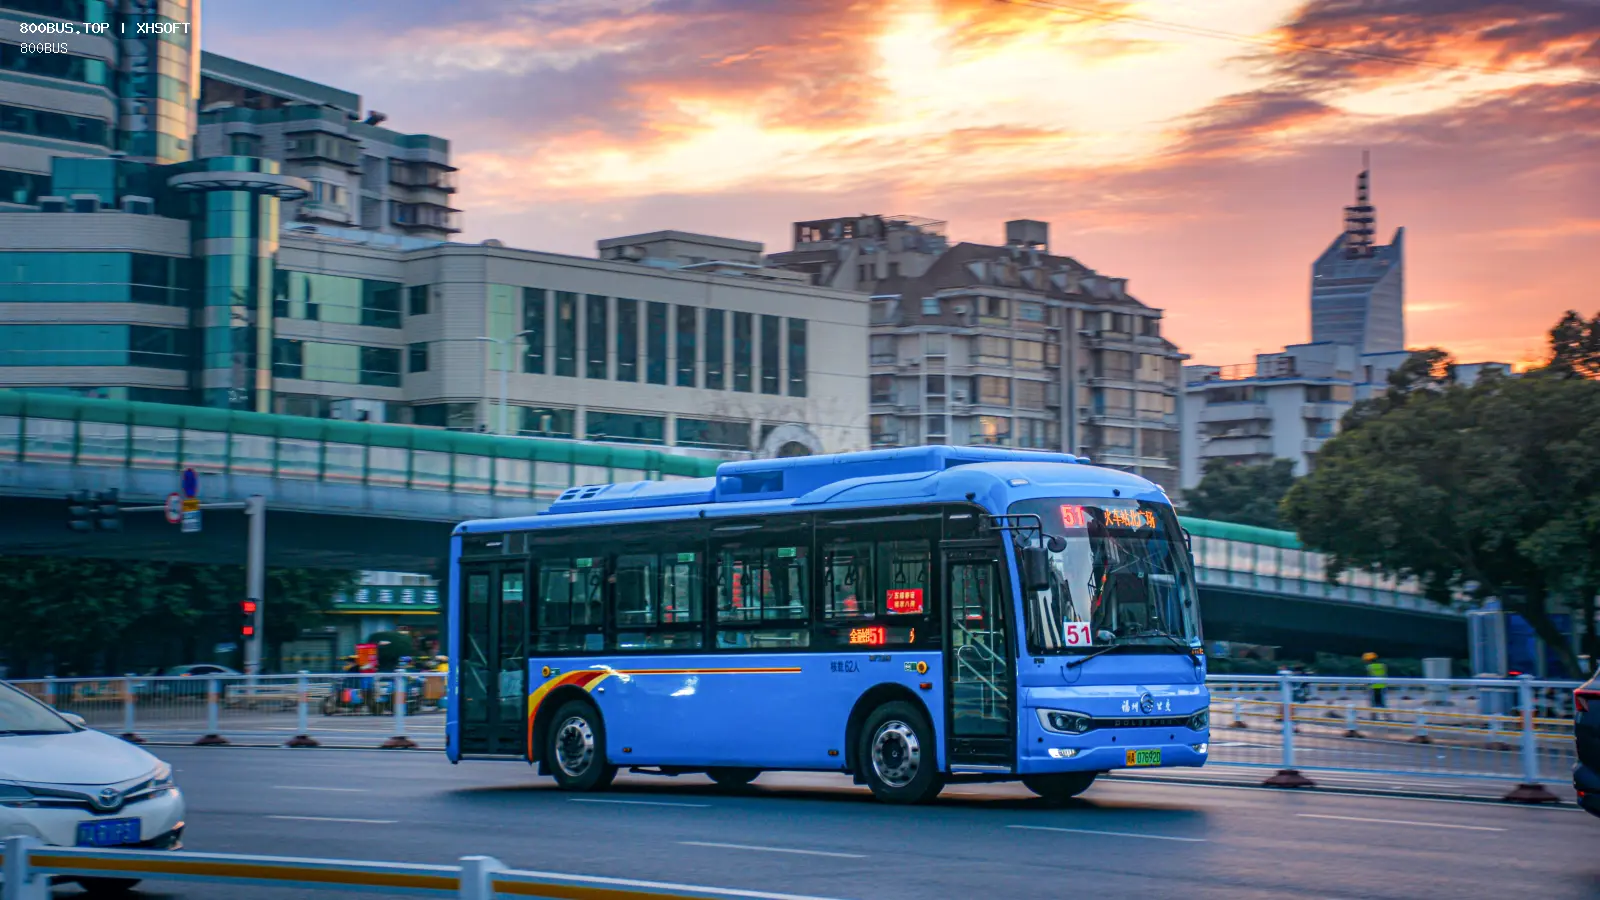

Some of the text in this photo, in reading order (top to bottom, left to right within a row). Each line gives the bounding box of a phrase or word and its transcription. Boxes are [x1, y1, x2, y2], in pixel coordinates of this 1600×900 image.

[1061, 505, 1085, 526] 51
[869, 627, 884, 644] 51
[1067, 625, 1090, 644] 51
